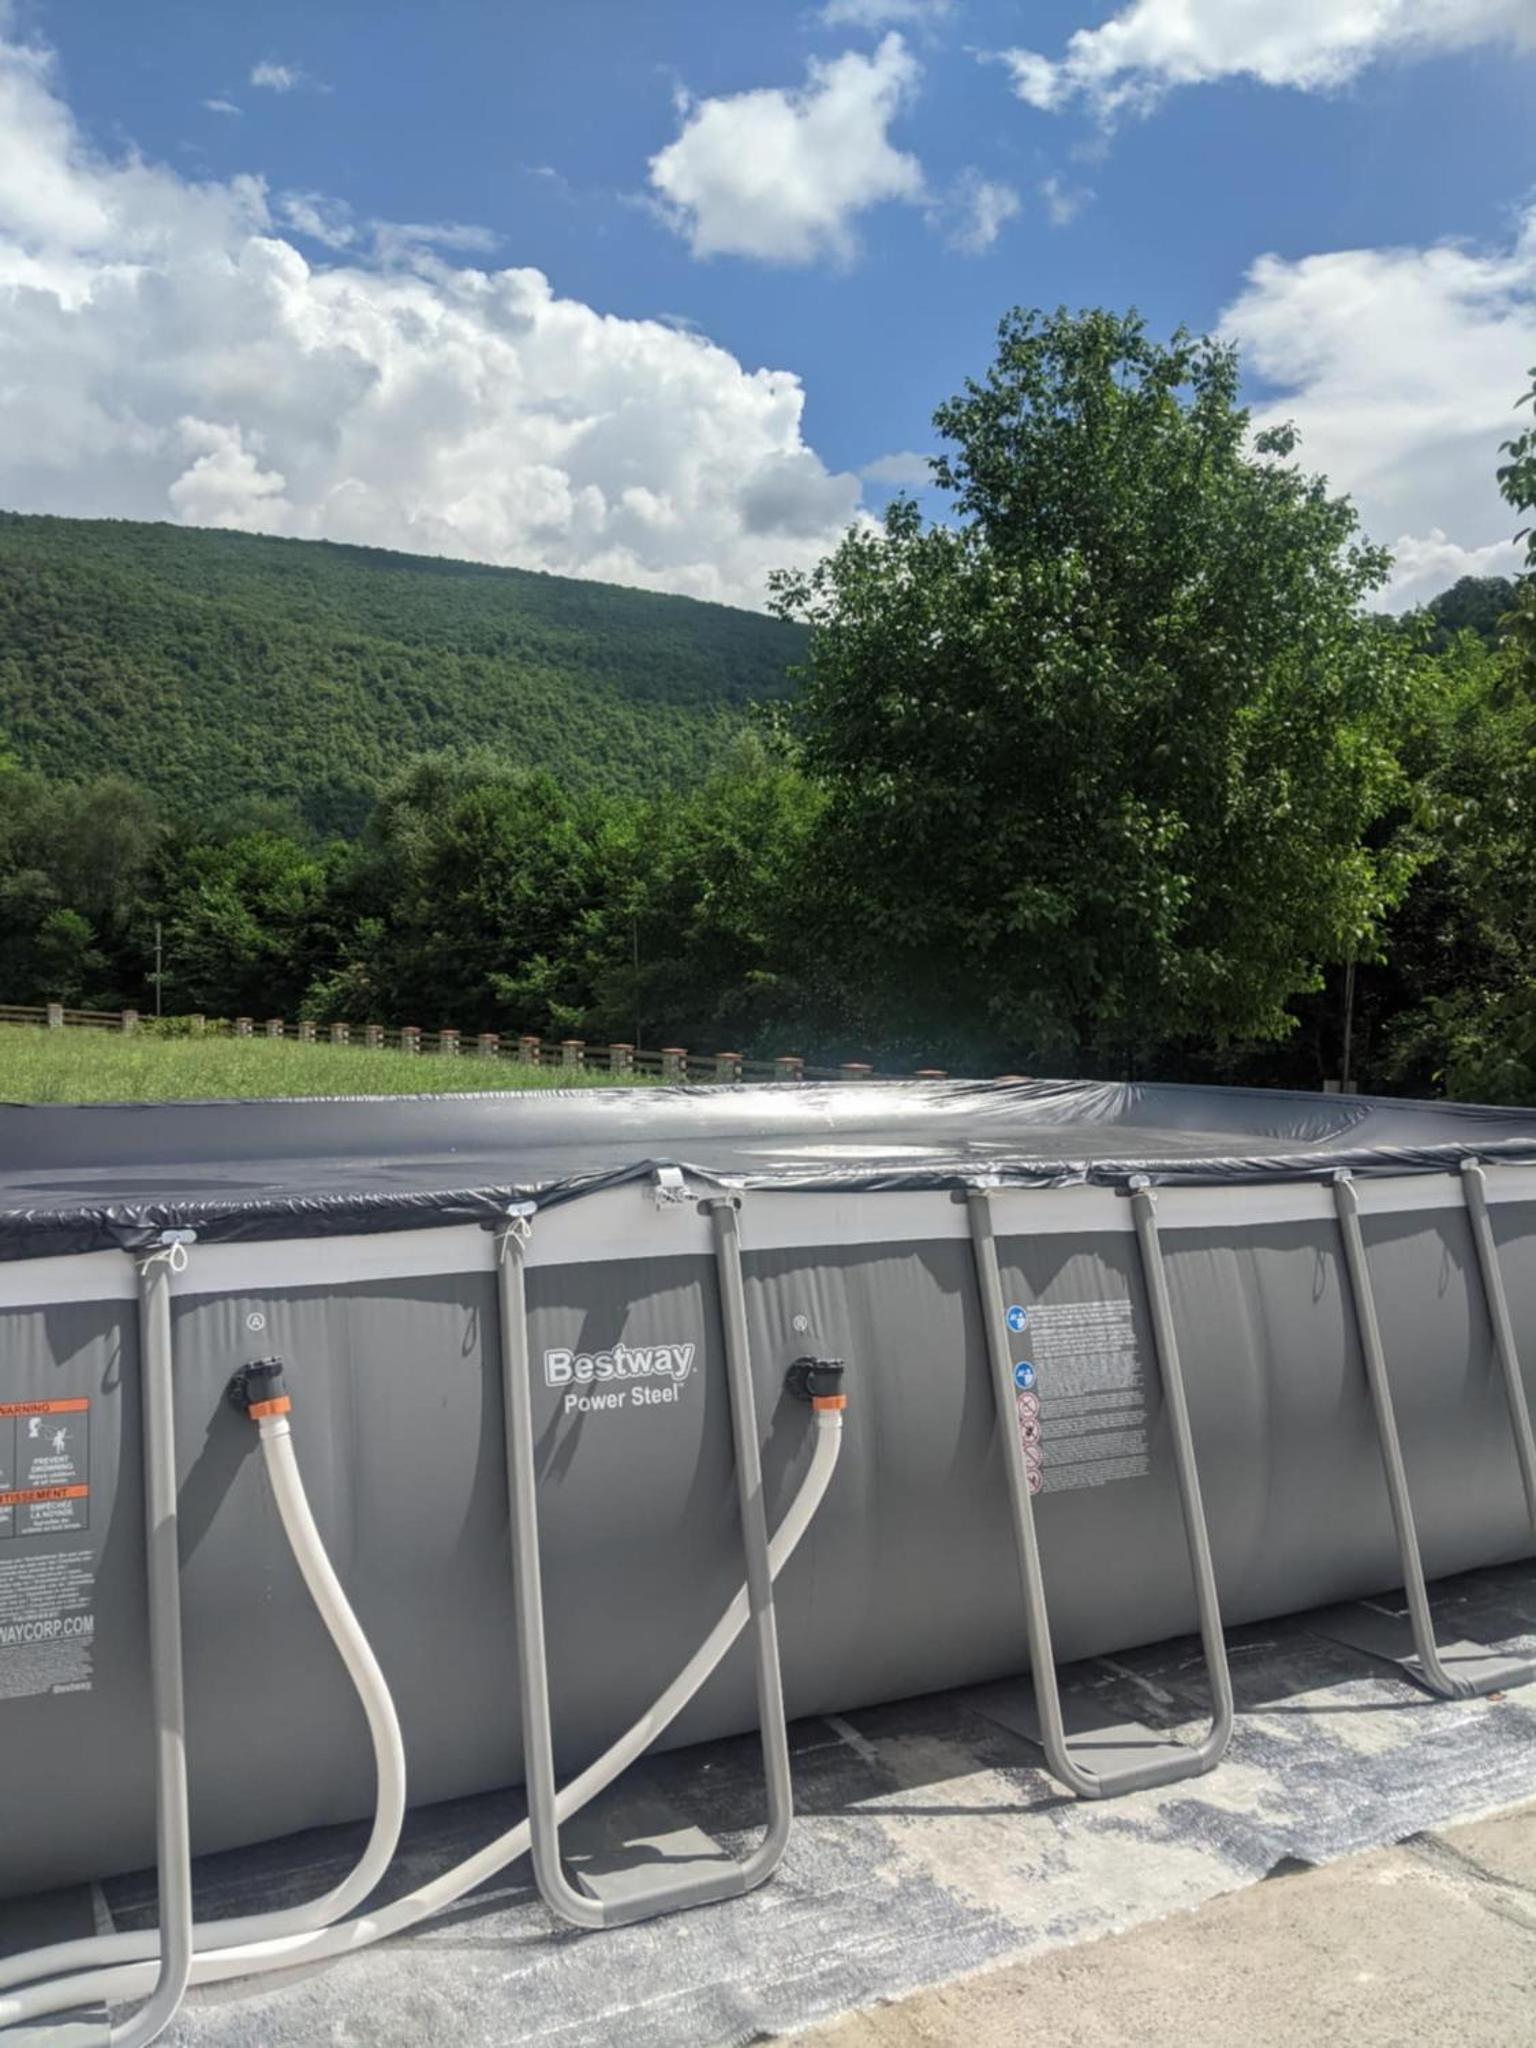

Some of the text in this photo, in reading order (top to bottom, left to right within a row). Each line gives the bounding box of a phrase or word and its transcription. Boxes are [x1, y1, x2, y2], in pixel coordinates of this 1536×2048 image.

[544, 1343, 695, 1387] Bestway
[564, 1382, 679, 1415] Power Steel
